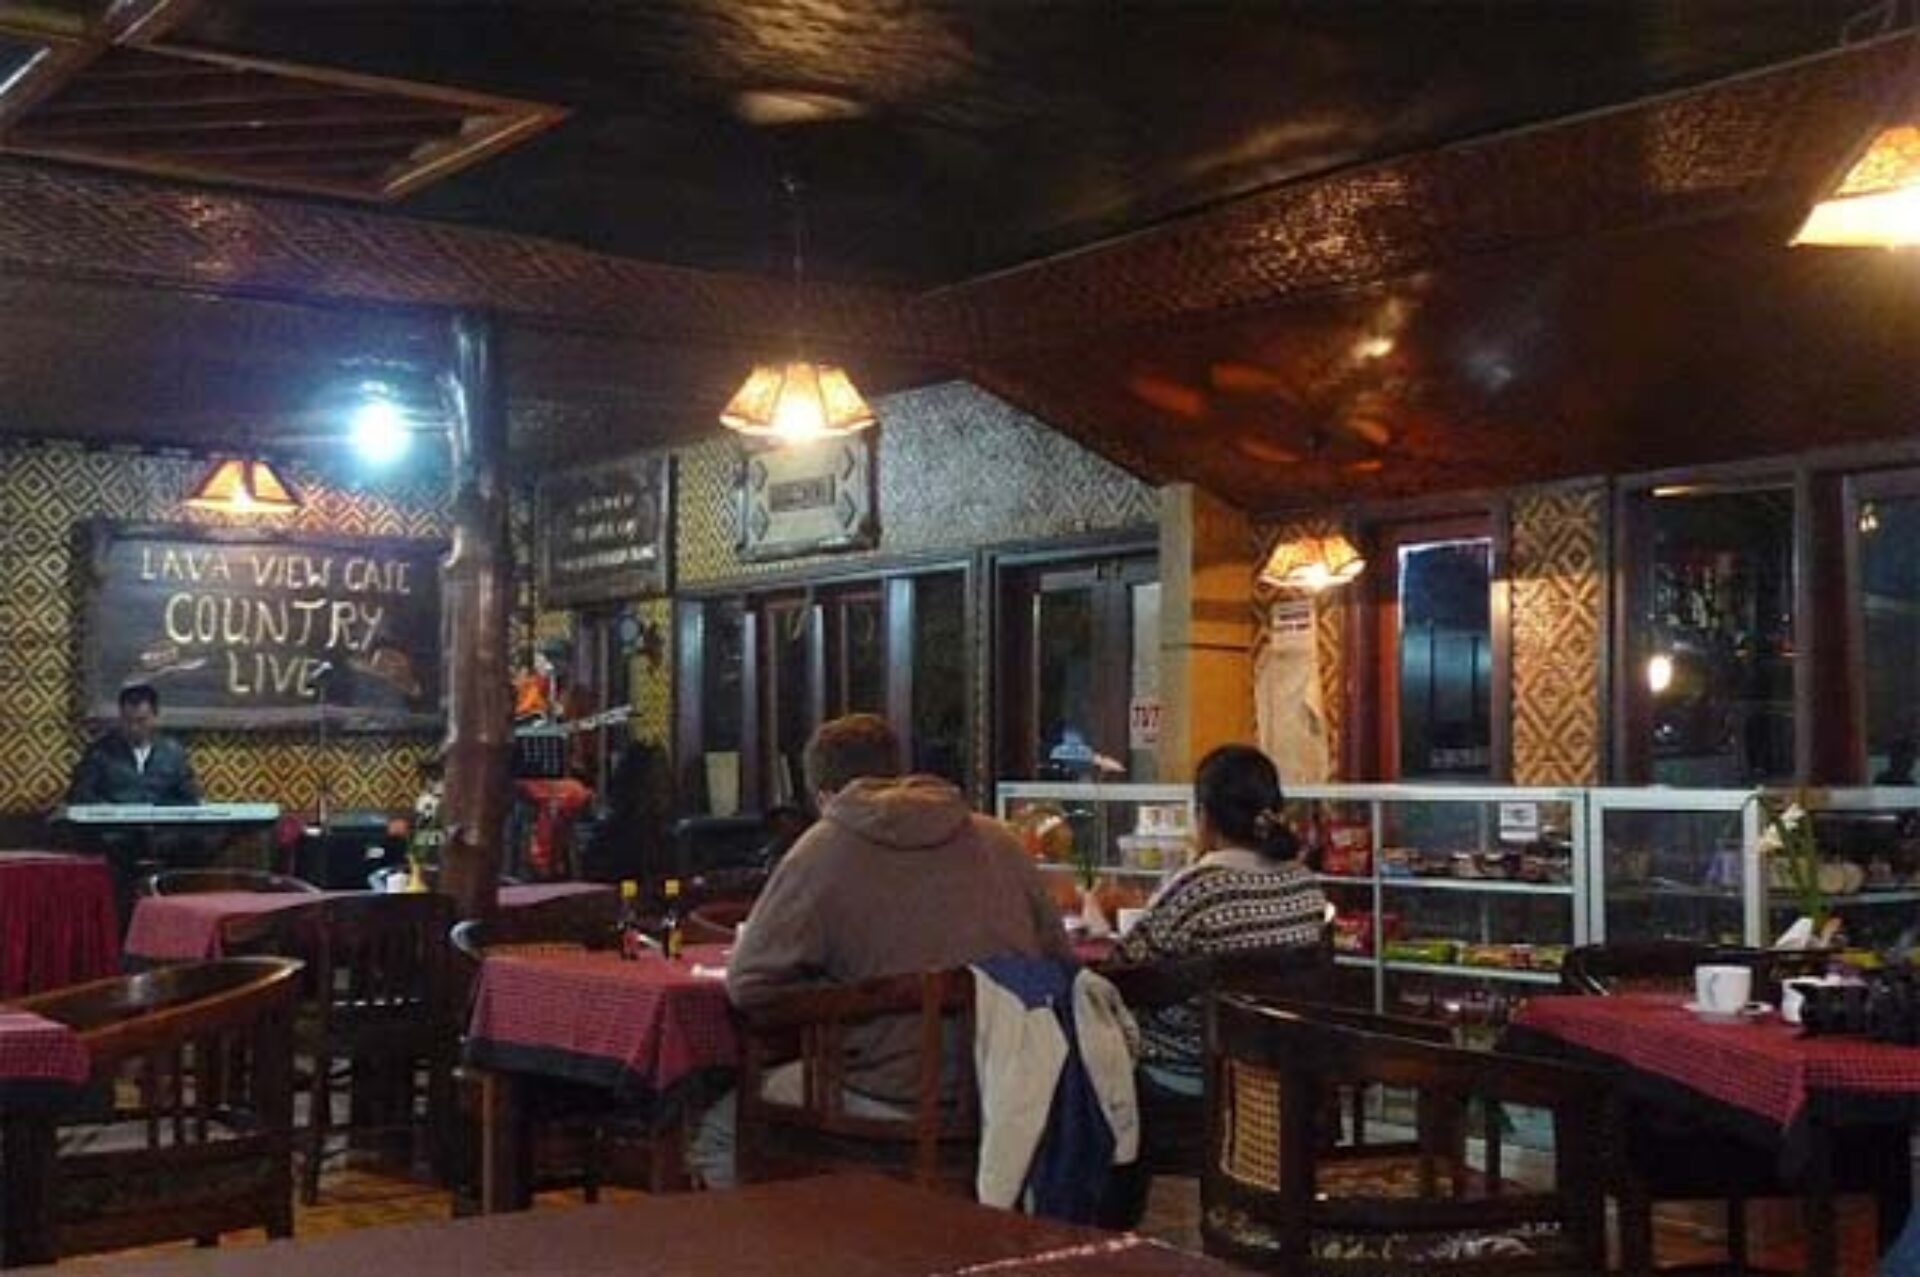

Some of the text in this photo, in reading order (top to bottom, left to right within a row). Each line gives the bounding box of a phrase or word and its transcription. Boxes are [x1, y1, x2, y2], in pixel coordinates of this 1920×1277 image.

[141, 547, 231, 582] LAVA
[251, 555, 333, 592] VIEW
[164, 593, 384, 650] COUNTRY
[227, 651, 320, 697] LIVE
